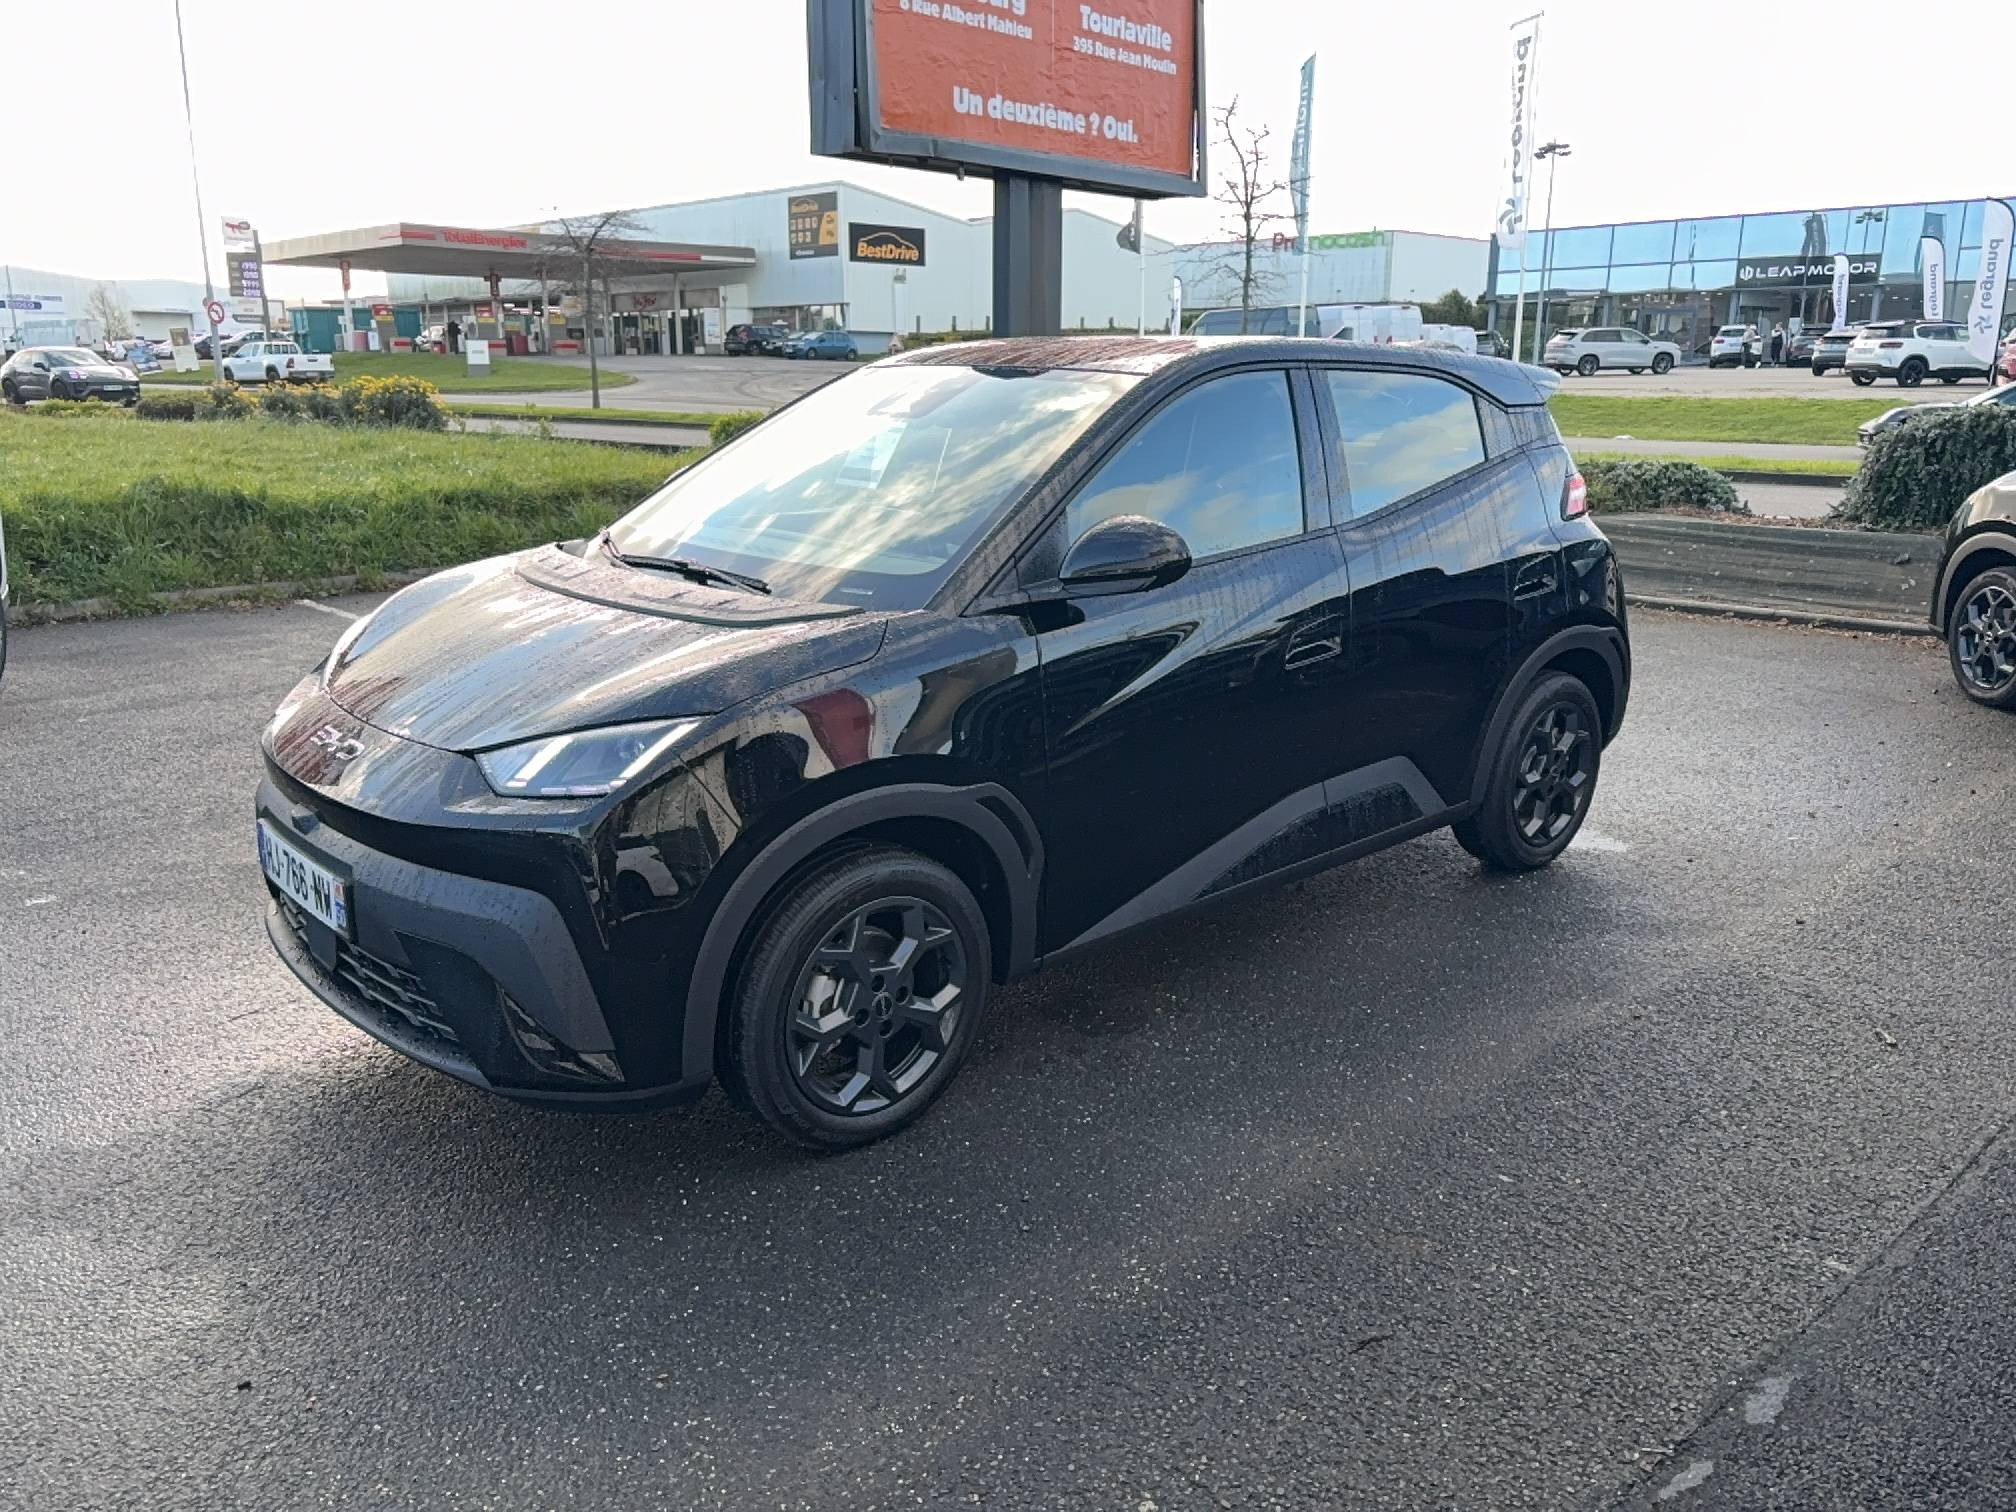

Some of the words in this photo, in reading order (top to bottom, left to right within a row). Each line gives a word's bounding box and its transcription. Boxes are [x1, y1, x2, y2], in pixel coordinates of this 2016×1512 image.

[942, 3, 985, 29] Albert
[1073, 35, 1094, 55] 395
[1095, 41, 1117, 60] Rue
[1118, 47, 1142, 66] Jean
[1143, 53, 1177, 75] Moulin
[953, 85, 983, 116] Un
[987, 93, 1086, 134] deuxième
[1089, 112, 1100, 136] ?
[1103, 115, 1138, 143] Oui.
[857, 240, 920, 261] BestDrive
[1755, 261, 1878, 279] LEAPMOOR
